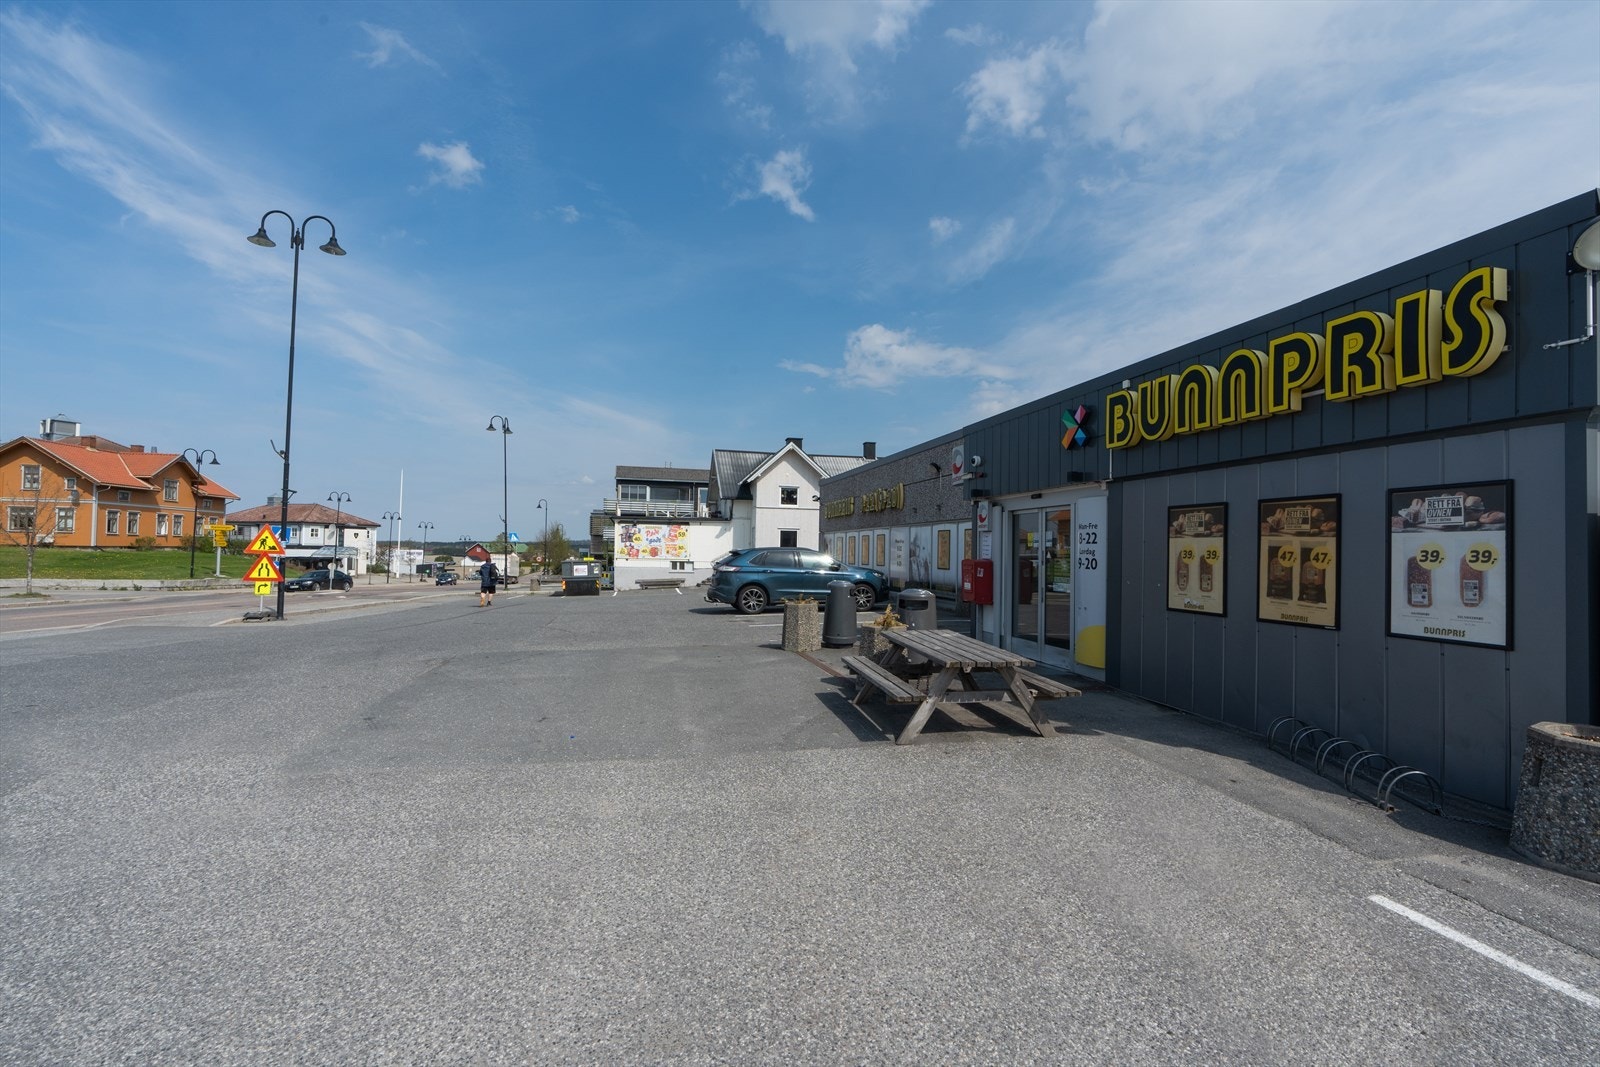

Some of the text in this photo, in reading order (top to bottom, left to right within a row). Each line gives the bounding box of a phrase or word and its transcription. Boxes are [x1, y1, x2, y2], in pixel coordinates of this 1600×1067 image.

[1105, 266, 1508, 449] BUNNPRIS
[1427, 498, 1461, 508] RETT FRA
[1427, 508, 1452, 518] OVNEN
[1418, 549, 1445, 564] 39,-
[1468, 549, 1498, 565] 39,-
[1423, 626, 1466, 638] BUNNPRIS
